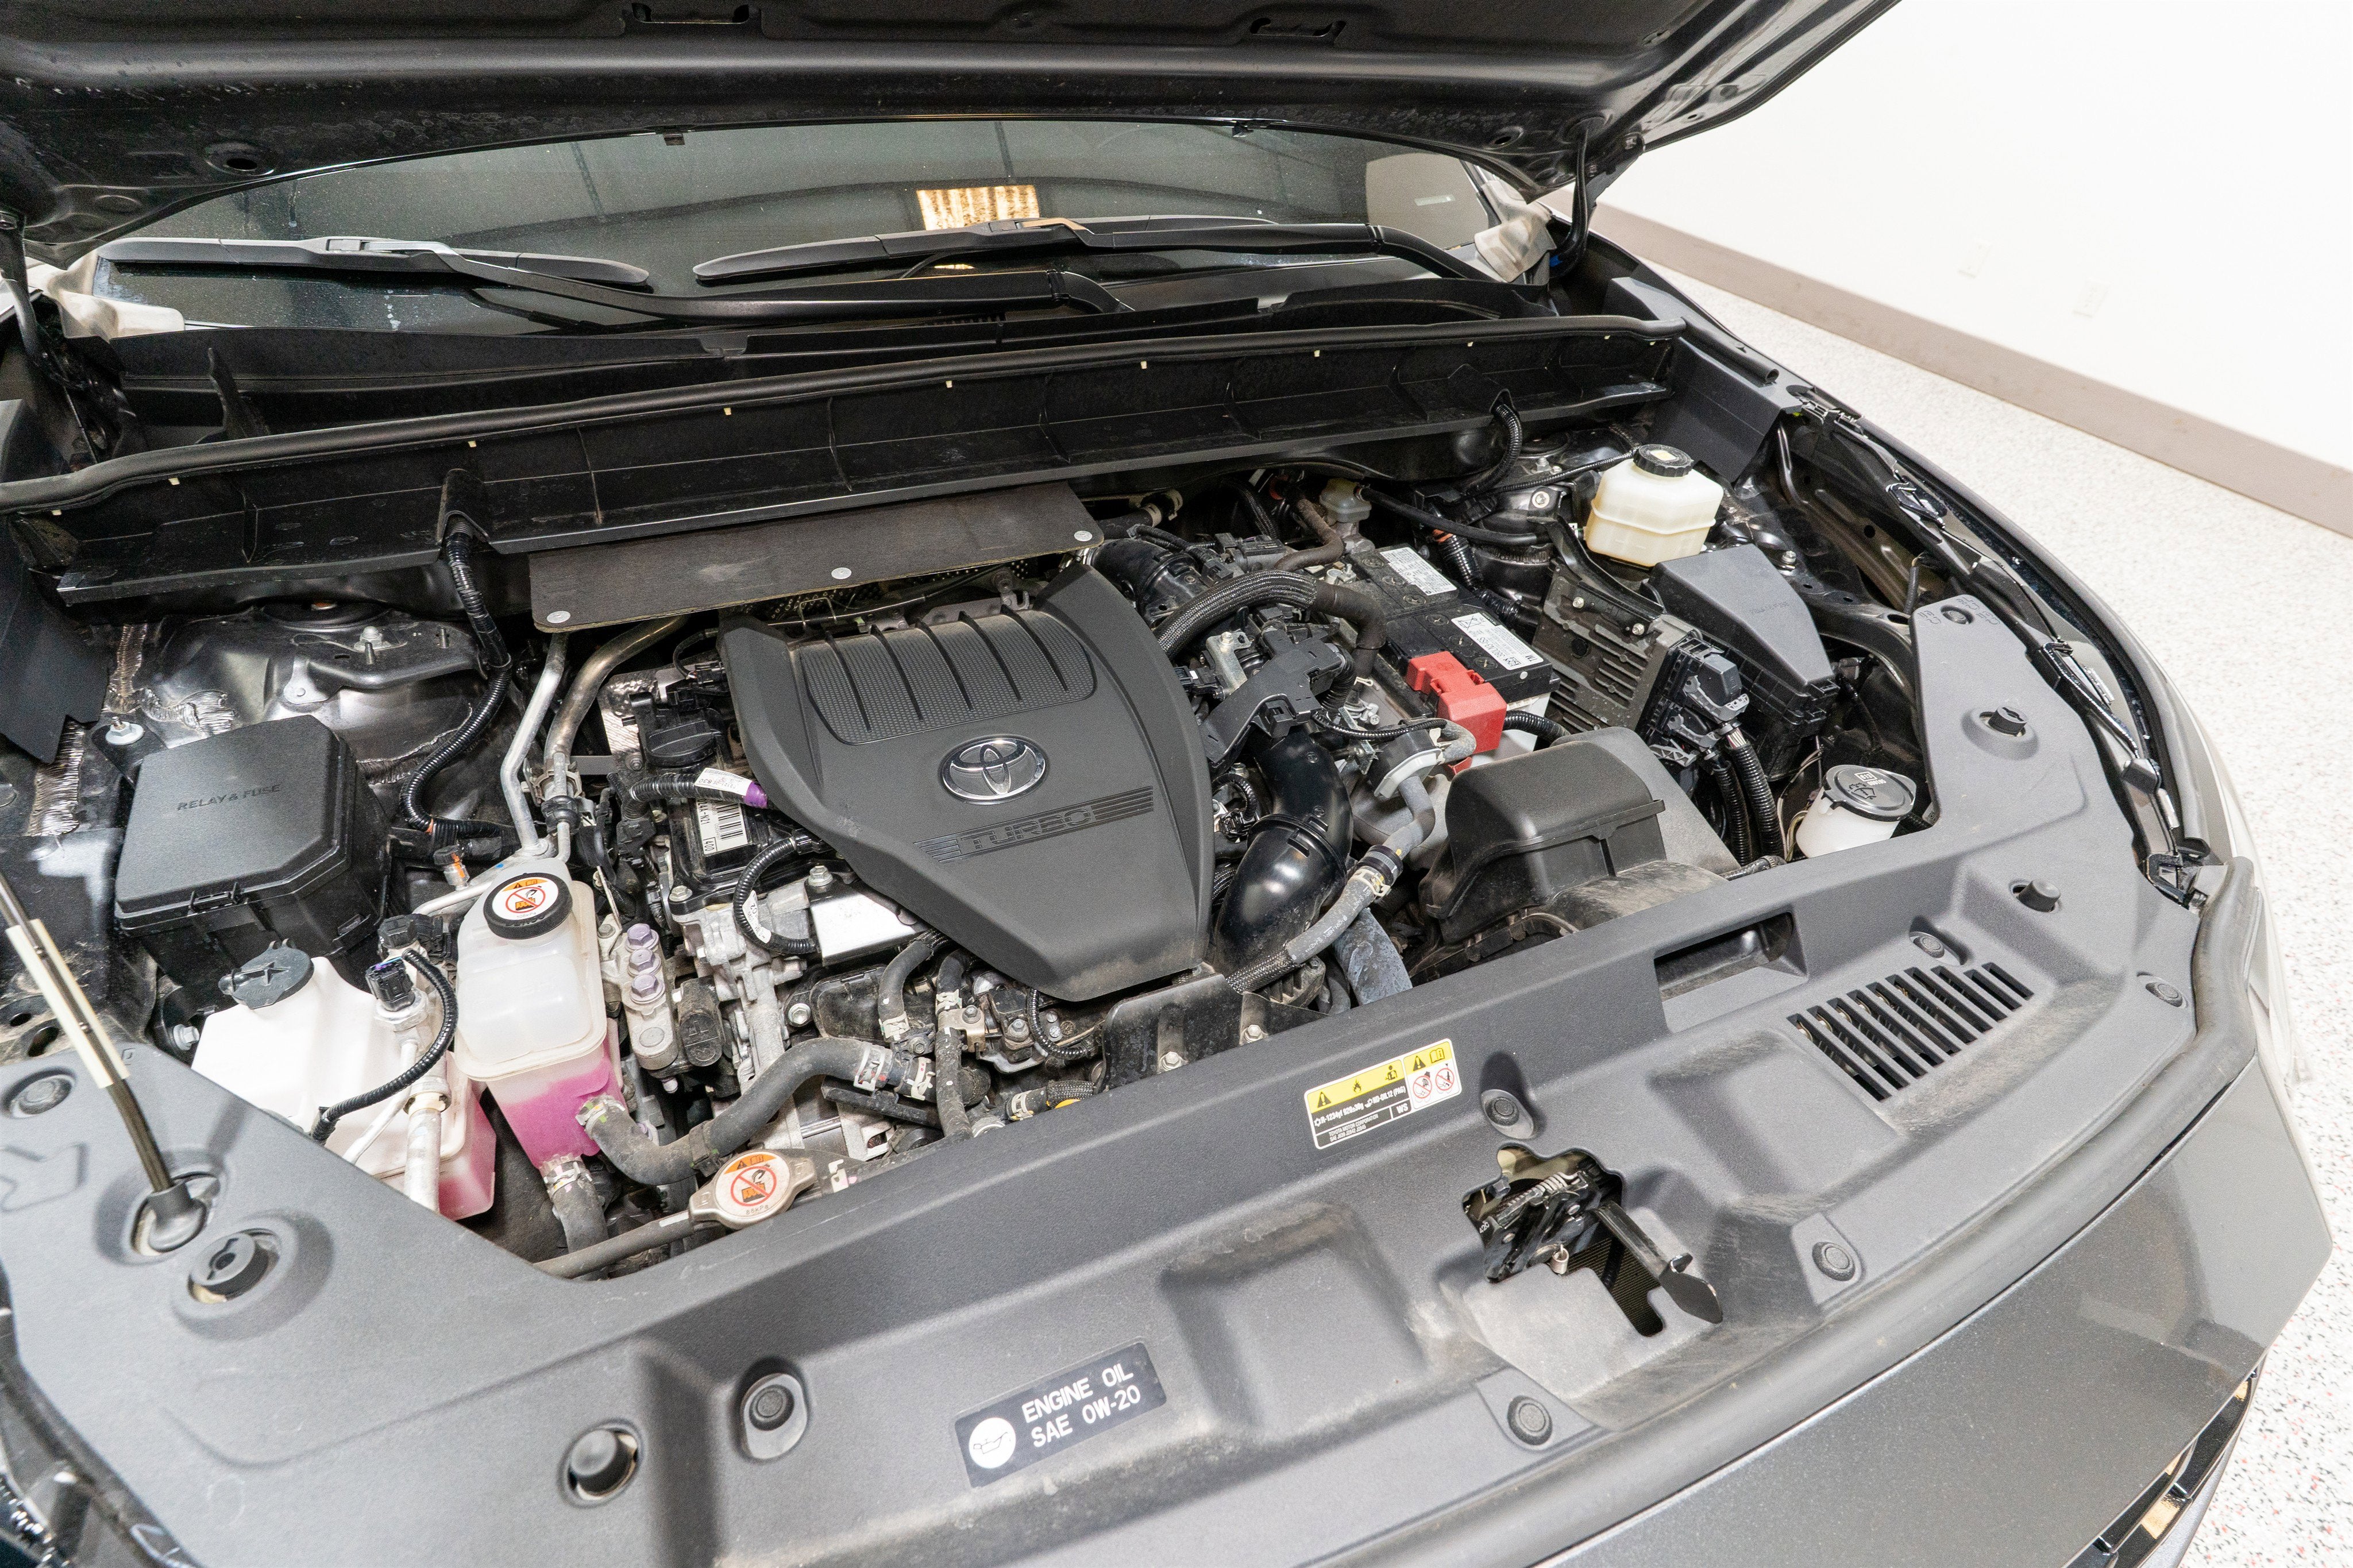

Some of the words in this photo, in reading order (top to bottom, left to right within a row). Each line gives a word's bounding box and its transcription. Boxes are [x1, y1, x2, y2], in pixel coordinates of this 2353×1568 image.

[177, 794, 227, 811] RELAY
[242, 783, 281, 799] FUSE
[961, 808, 1091, 849] TURBO
[704, 840, 715, 852] 400
[1396, 1103, 1409, 1114] WS
[1328, 1127, 1343, 1137] TOYOTA
[1342, 1123, 1356, 1132] MOTOR
[1355, 1113, 1379, 1127] CORPORATION
[746, 1204, 769, 1215] 88kPa
[1479, 1221, 1490, 1234] 420
[1021, 1377, 1094, 1424] ENGINE
[1101, 1363, 1134, 1387] OIL
[1031, 1413, 1073, 1448] SAE
[1082, 1385, 1141, 1424] 0W-20
